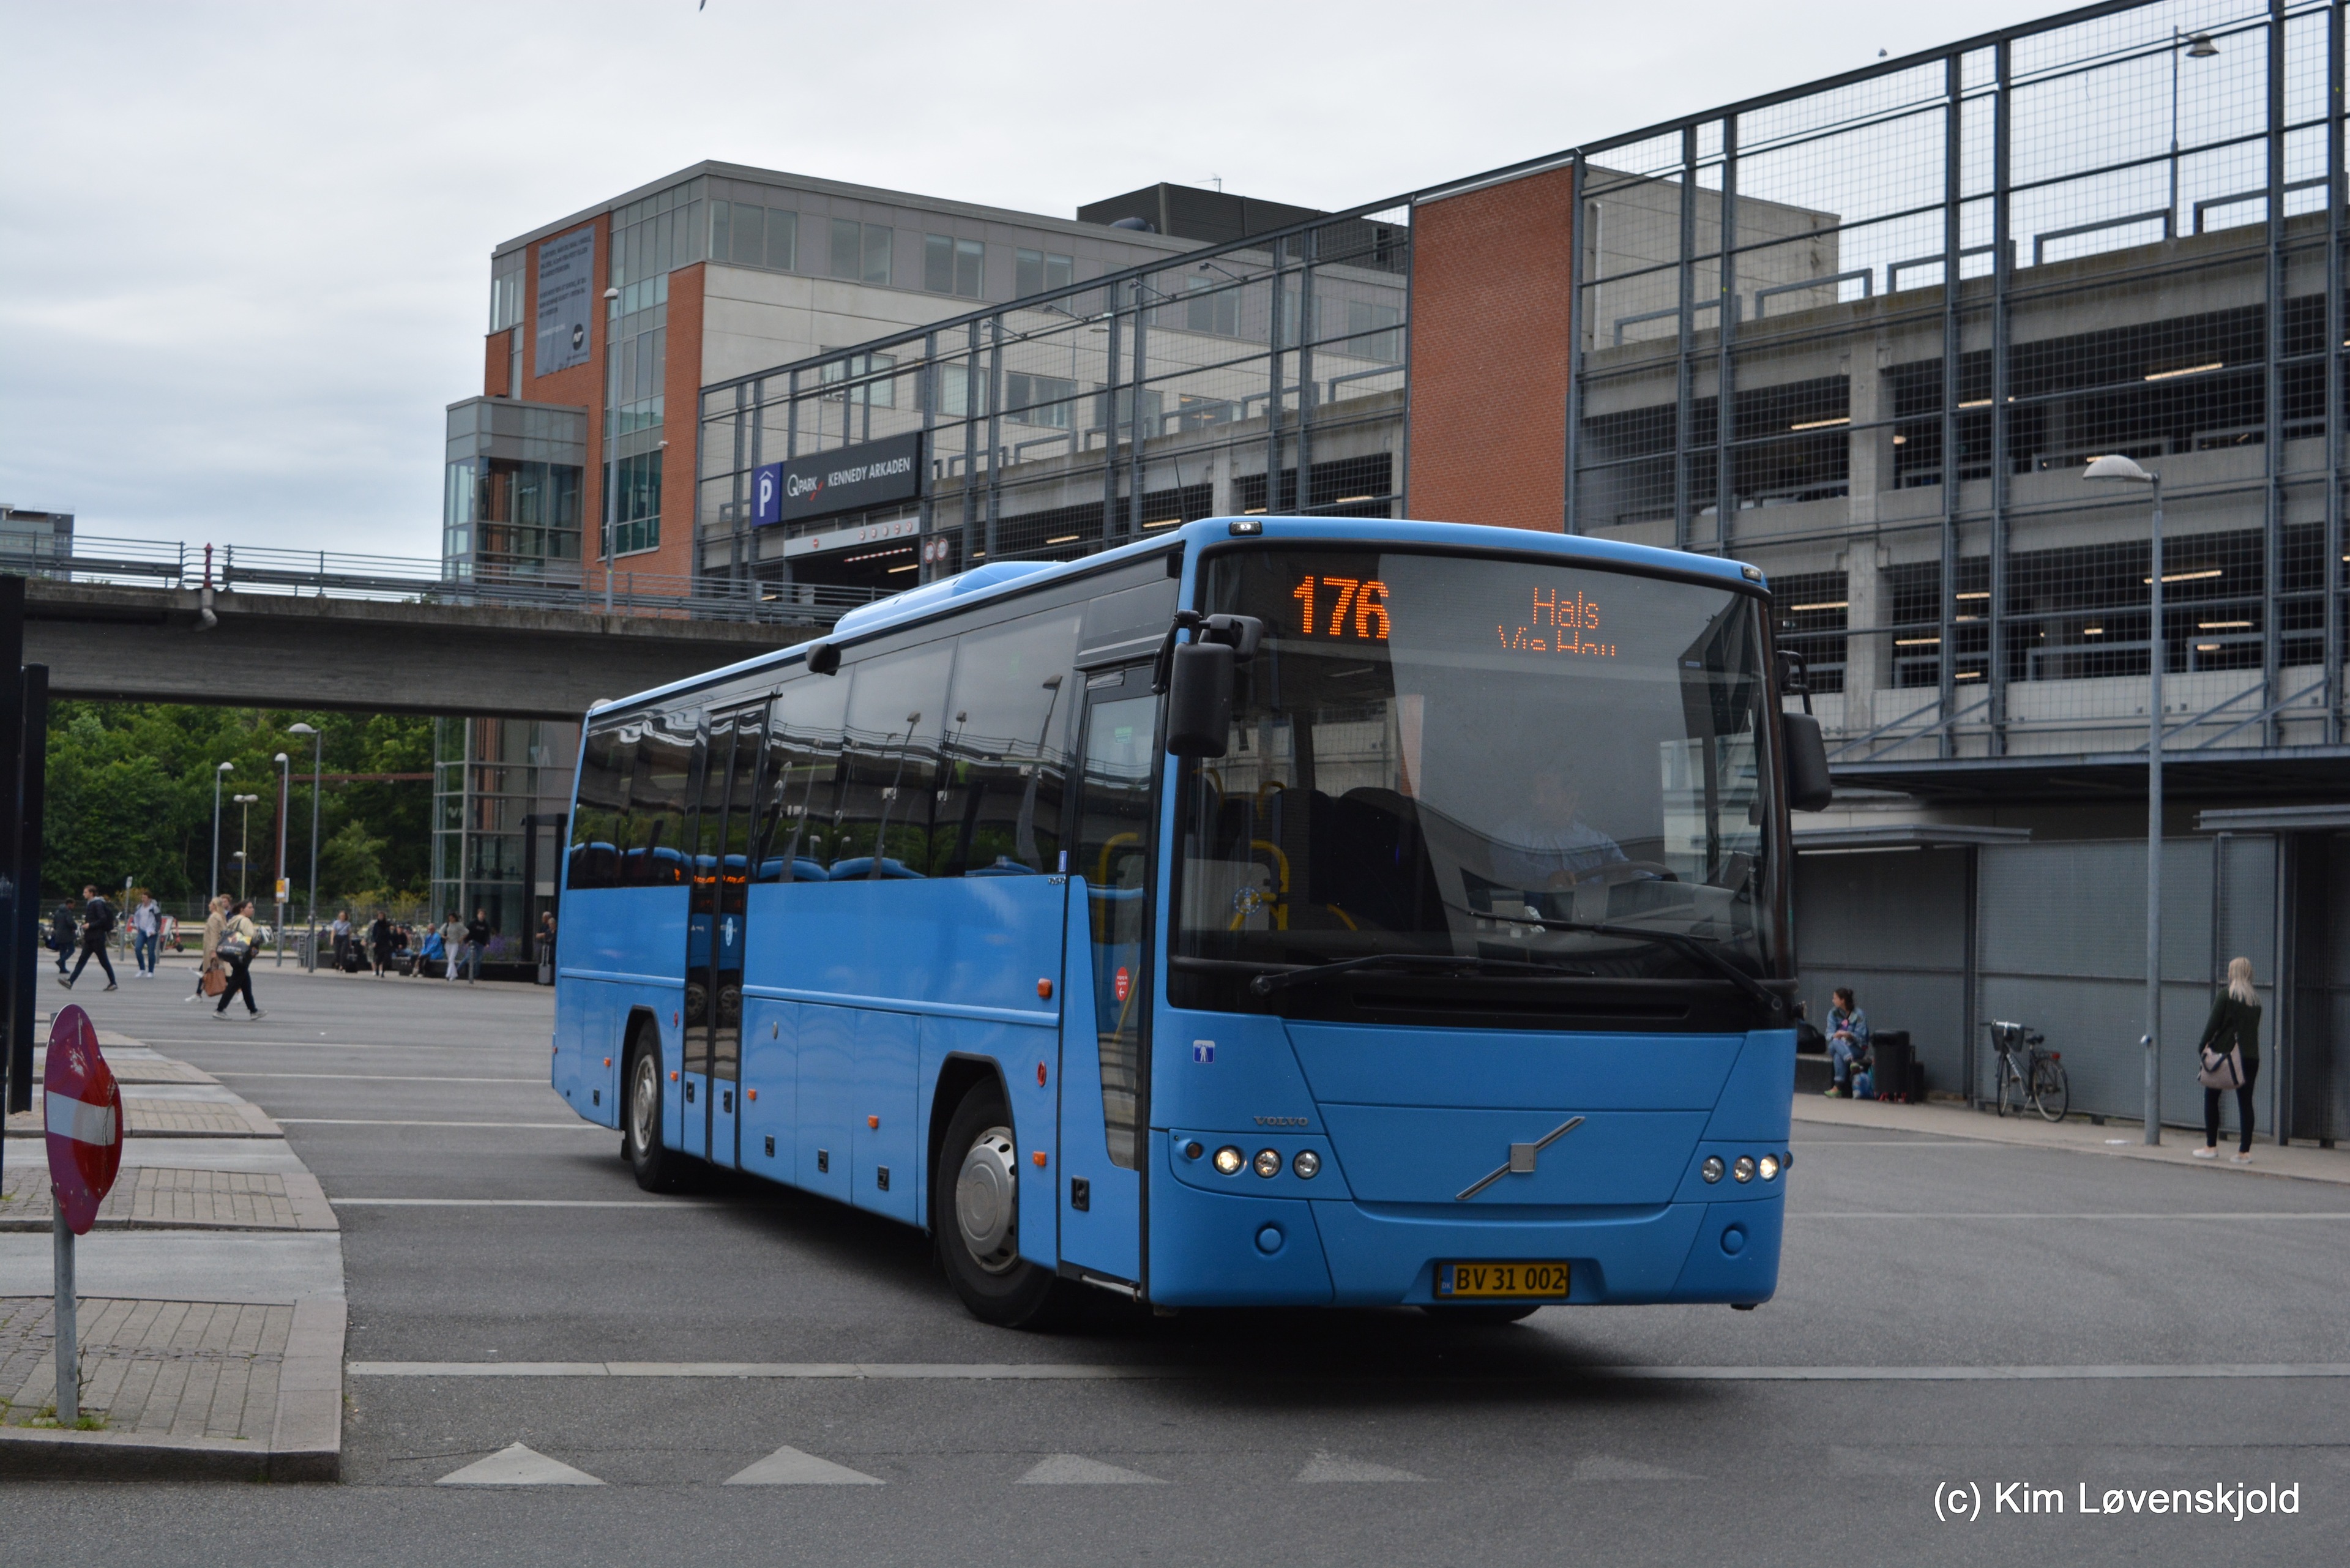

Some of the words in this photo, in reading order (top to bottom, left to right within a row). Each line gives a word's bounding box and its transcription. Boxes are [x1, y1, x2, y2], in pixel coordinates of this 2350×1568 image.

[828, 466, 868, 487] KENNEDY
[869, 457, 911, 479] ARKADEN
[1294, 575, 1390, 639] 176
[1533, 587, 1599, 629] Hals
[1254, 1116, 1308, 1126] VOLVO
[1457, 1268, 1486, 1290] BV
[1492, 1268, 1515, 1290] 31
[1524, 1267, 1564, 1290] 002
